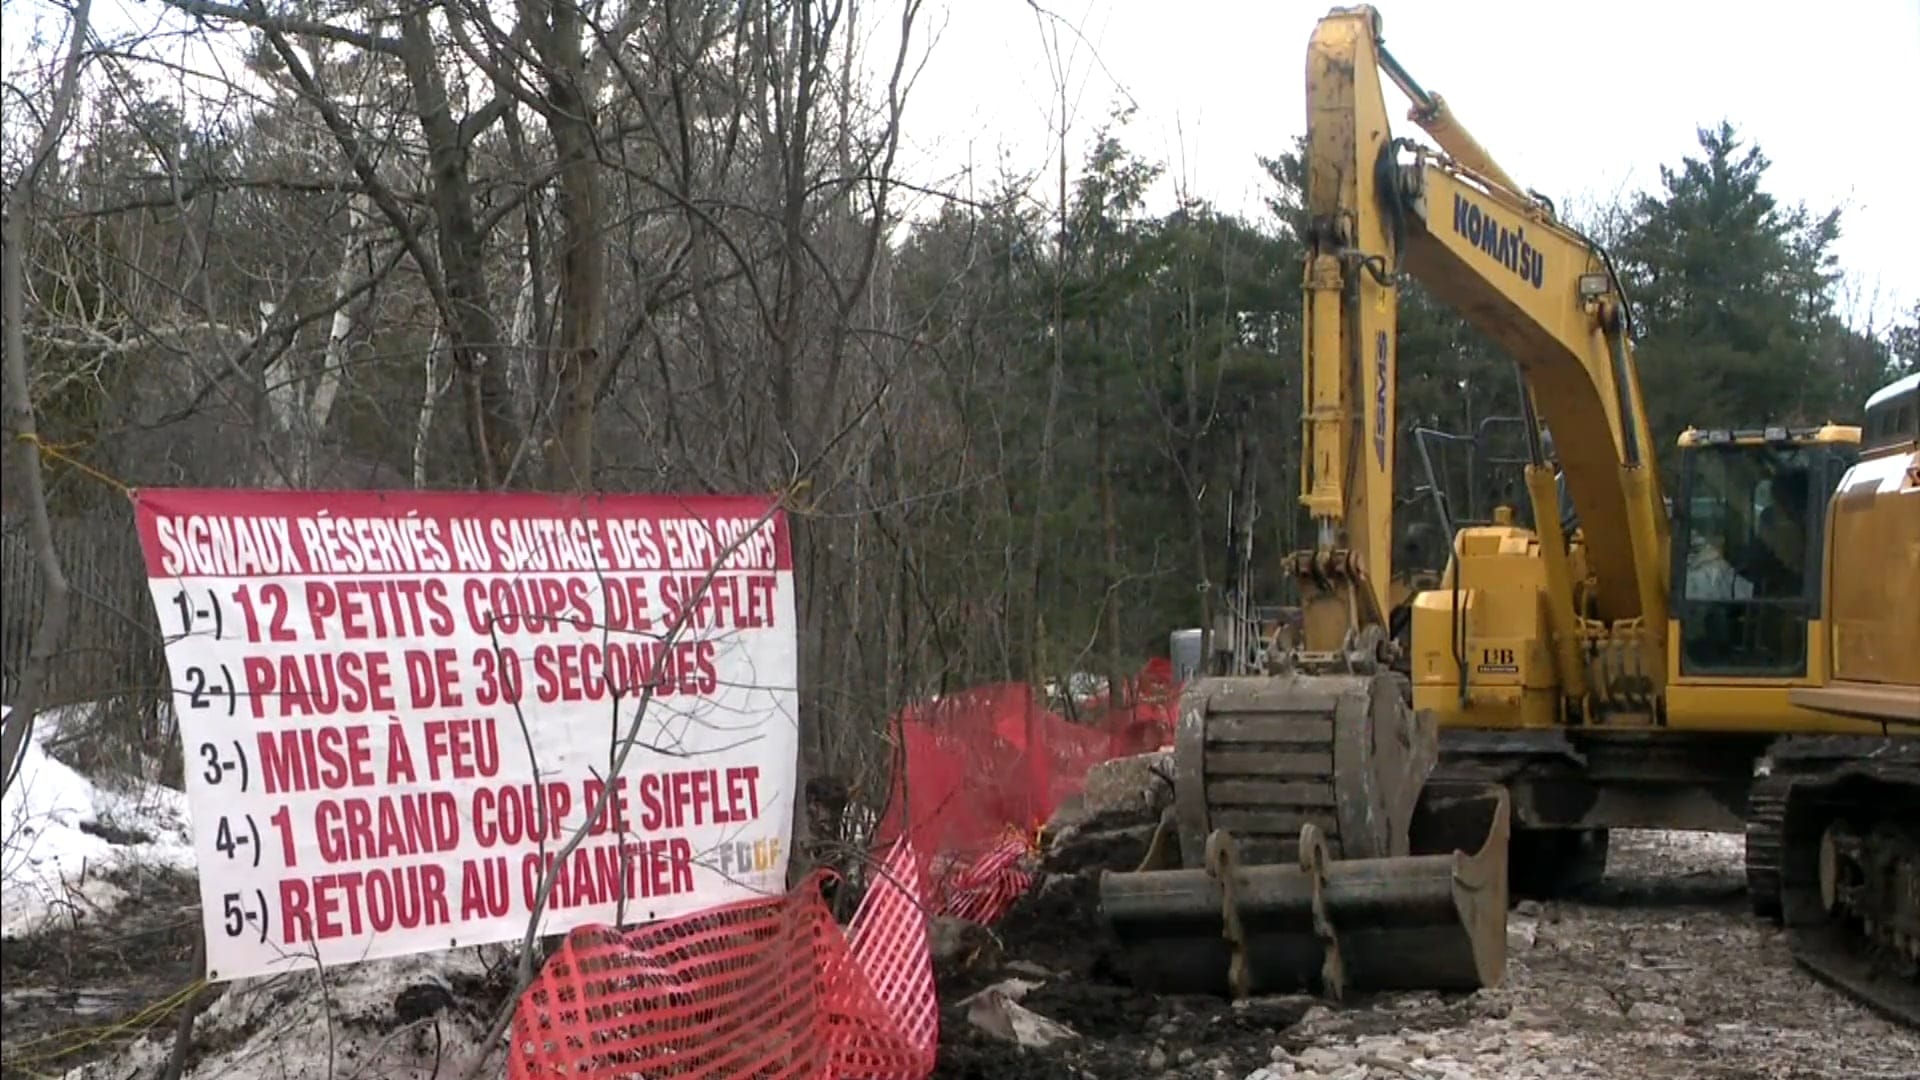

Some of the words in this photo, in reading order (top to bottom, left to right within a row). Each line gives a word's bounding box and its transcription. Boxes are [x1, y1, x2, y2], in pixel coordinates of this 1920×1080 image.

[1453, 192, 1544, 290] KOMATSU
[156, 514, 301, 576] SIGNAUX
[297, 508, 450, 574] RÉSERVÉS
[450, 517, 492, 573] AU
[490, 517, 609, 573] SAUTAGE
[606, 516, 662, 571] DES
[659, 516, 777, 570] EXPLOSIFS
[172, 588, 222, 641] 1-)
[231, 582, 297, 643] 12
[304, 578, 455, 640] PETITS
[463, 577, 596, 636] COUPS
[604, 575, 653, 631] DE
[659, 574, 778, 630] SIFFLET
[186, 663, 236, 716] 2-)
[243, 650, 396, 718] PAUSE
[404, 647, 464, 709] DE
[473, 648, 523, 705] 30
[534, 640, 717, 702] SECONDES
[200, 740, 248, 792] 3-)
[256, 724, 375, 794] MISE
[387, 715, 417, 784] À
[423, 718, 500, 781] FEU
[215, 814, 261, 867] 4-)
[270, 804, 298, 867] 1
[315, 791, 459, 864] GRAND
[472, 781, 571, 848] COUP
[582, 776, 630, 837] DE
[639, 766, 760, 831] SIFFLET
[223, 889, 269, 943] 5-)
[278, 863, 451, 944] RETOUR
[460, 856, 511, 922] AU
[521, 837, 694, 912] CHANTIER
